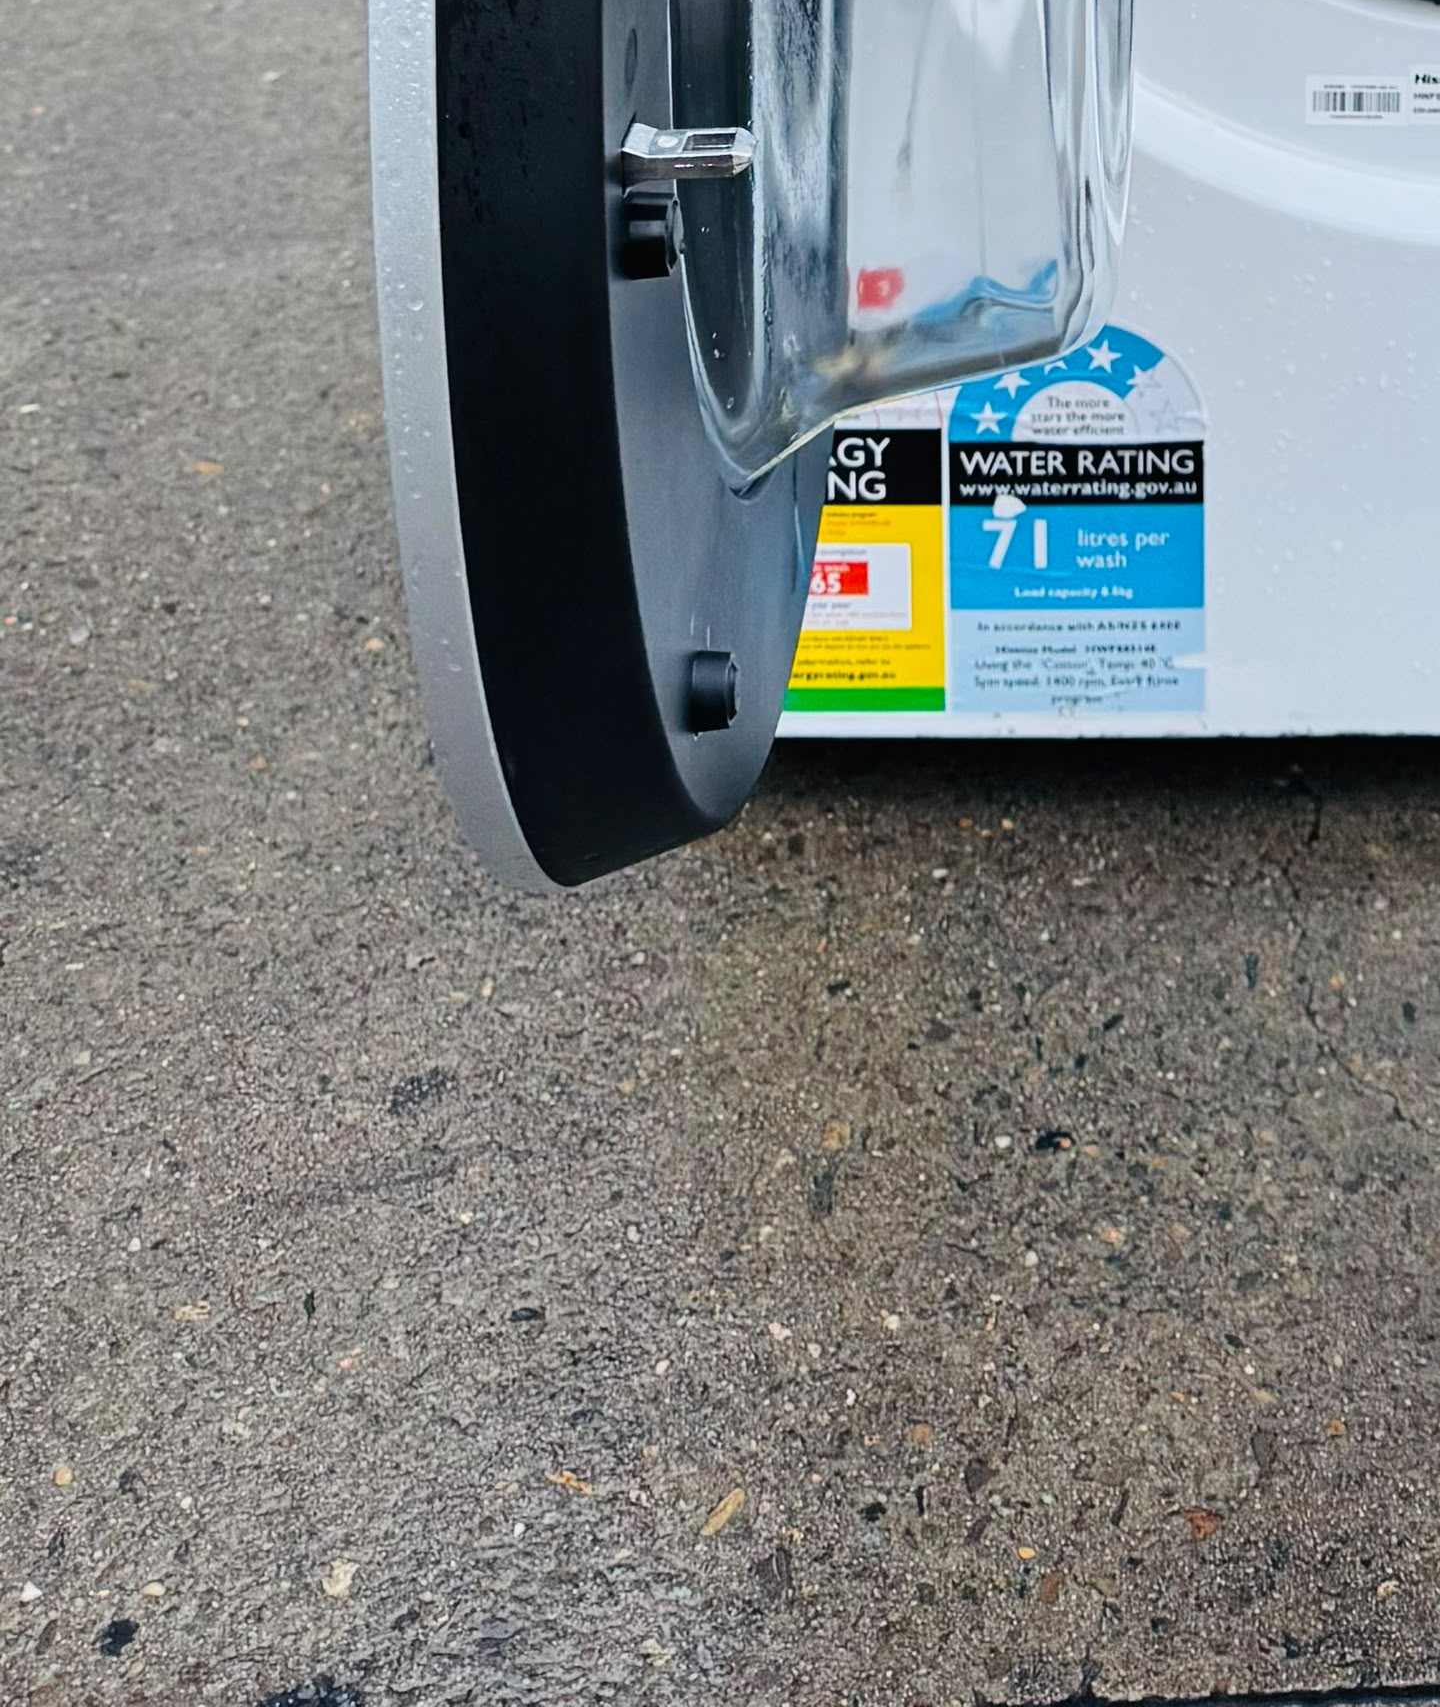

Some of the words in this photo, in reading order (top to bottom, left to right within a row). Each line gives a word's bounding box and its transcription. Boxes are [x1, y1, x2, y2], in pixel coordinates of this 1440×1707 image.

[1048, 397, 1071, 409] The
[1074, 399, 1109, 409] more
[1031, 411, 1062, 422] stars
[1066, 410, 1087, 422] the
[1090, 412, 1125, 422] more
[1031, 426, 1069, 435] water
[1073, 425, 1125, 435] efficient
[829, 437, 890, 467] GY
[960, 450, 1066, 476] WATER
[1078, 449, 1194, 476] RATING
[960, 479, 1197, 500] www.waterrating.gov.au
[1077, 529, 1128, 547] litres
[1136, 532, 1170, 551] per
[1076, 551, 1127, 568] wash
[1014, 586, 1045, 597] Load
[1067, 621, 1093, 631] with
